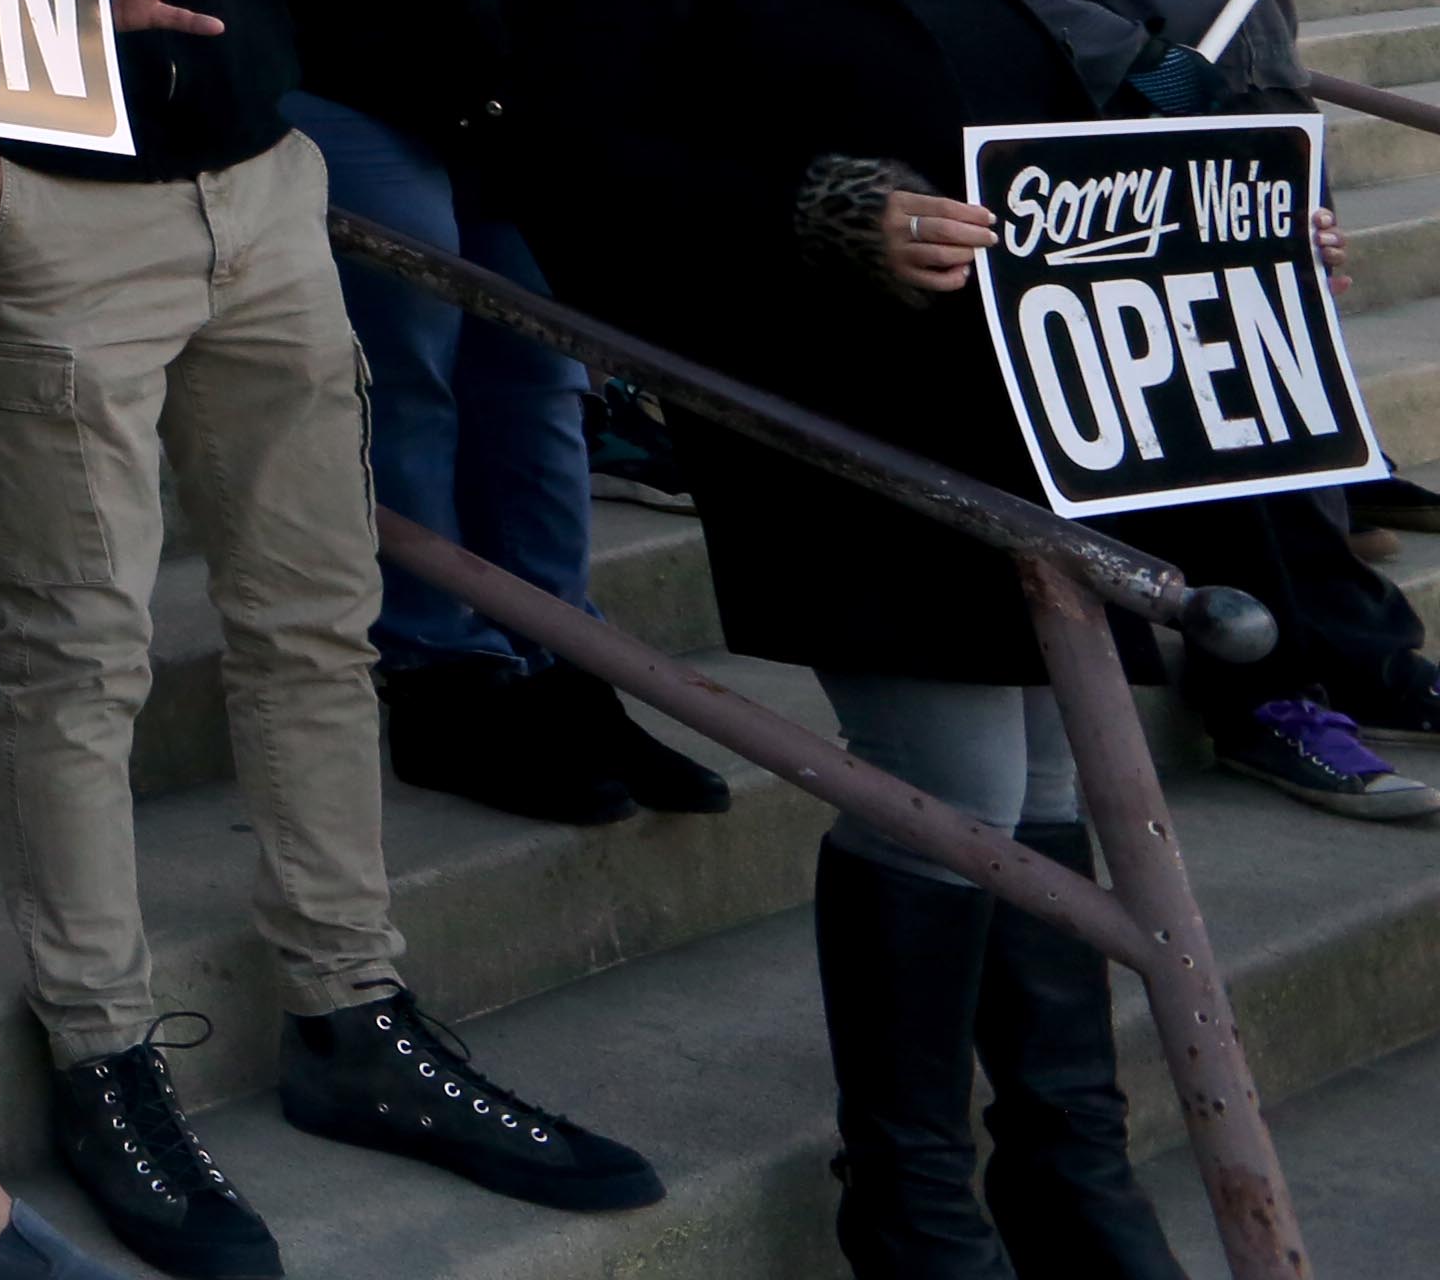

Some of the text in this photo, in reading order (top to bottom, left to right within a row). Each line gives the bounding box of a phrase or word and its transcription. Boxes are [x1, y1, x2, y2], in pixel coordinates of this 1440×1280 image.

[1004, 158, 1293, 267] Sorry We're
[1018, 261, 1339, 471] OPEN
